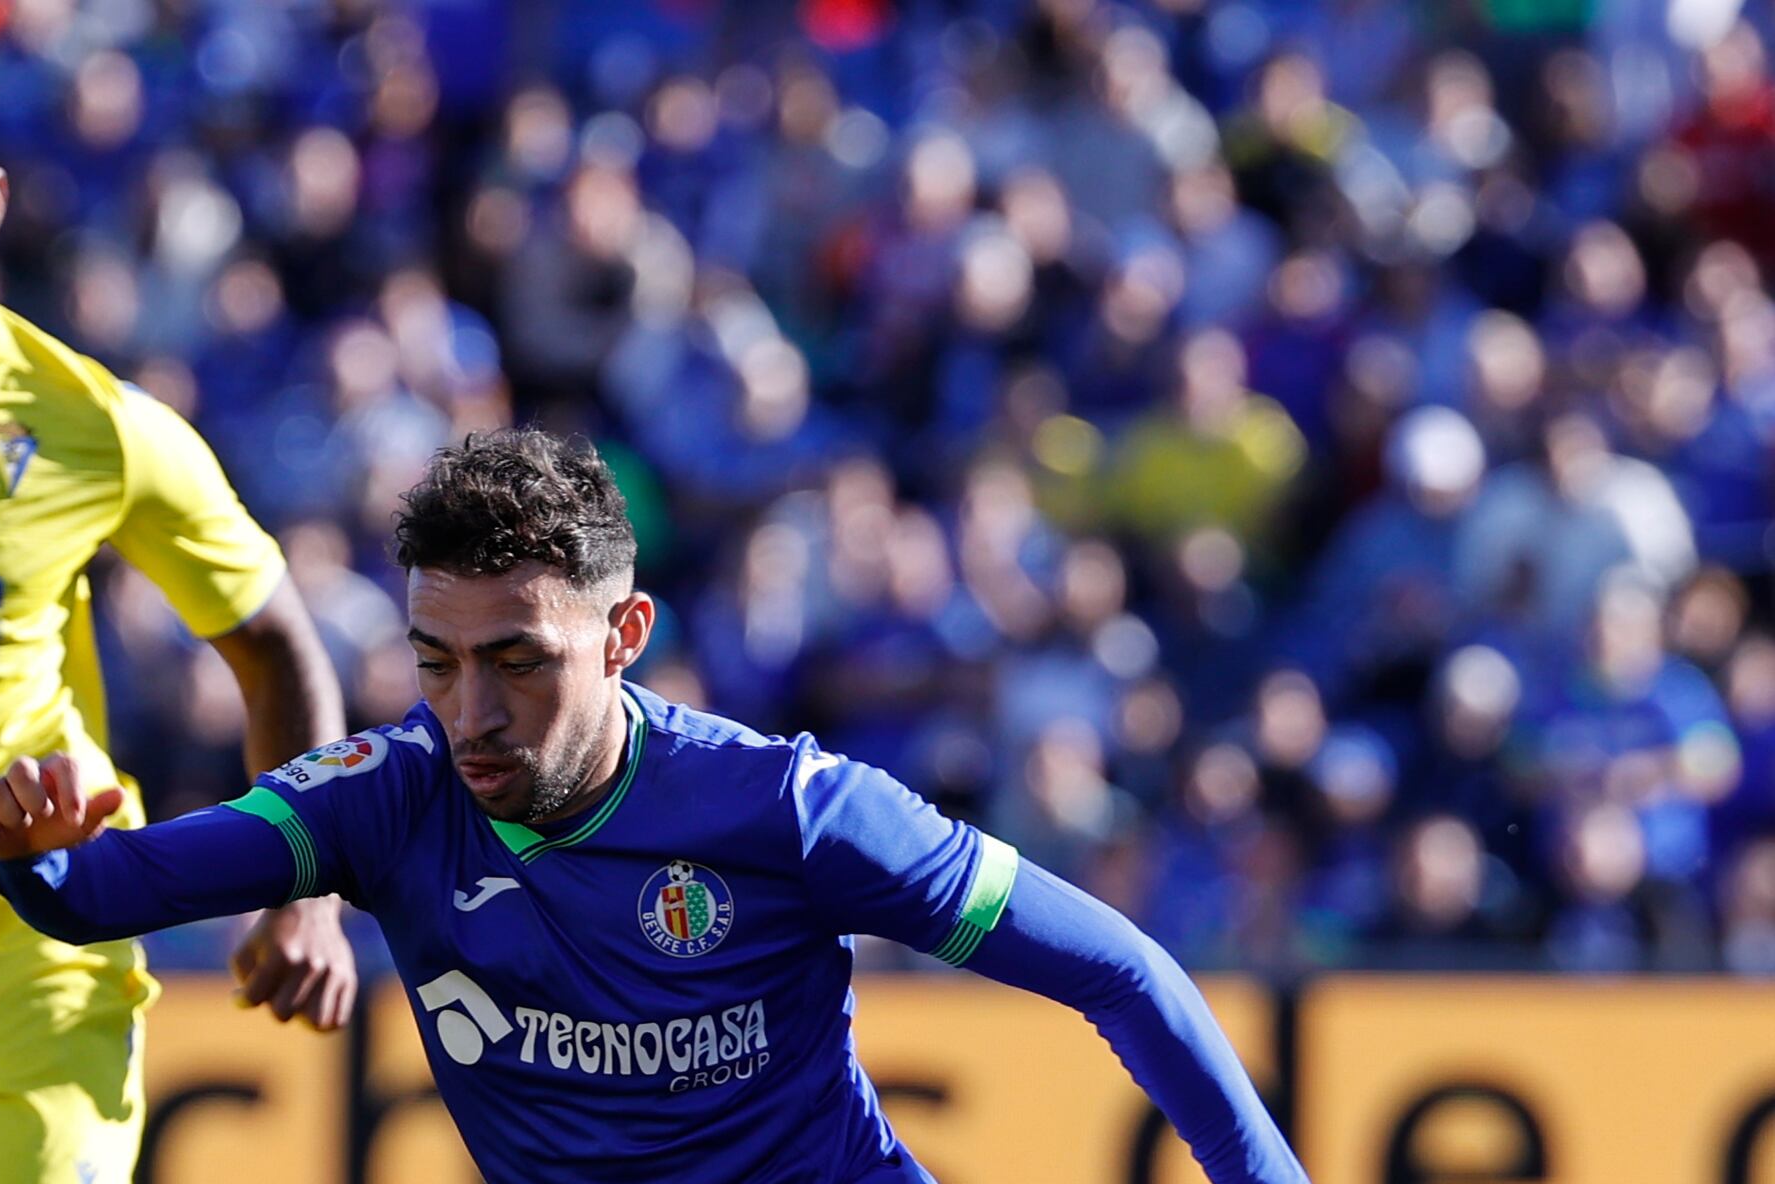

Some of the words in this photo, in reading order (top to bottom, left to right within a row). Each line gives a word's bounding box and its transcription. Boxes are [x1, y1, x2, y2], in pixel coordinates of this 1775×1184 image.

[642, 911, 681, 953] GETAFE
[686, 937, 712, 954] C.F.
[711, 900, 731, 938] S.A.D.
[514, 999, 768, 1076] TECNOCASA
[669, 1051, 771, 1092] GROUP
